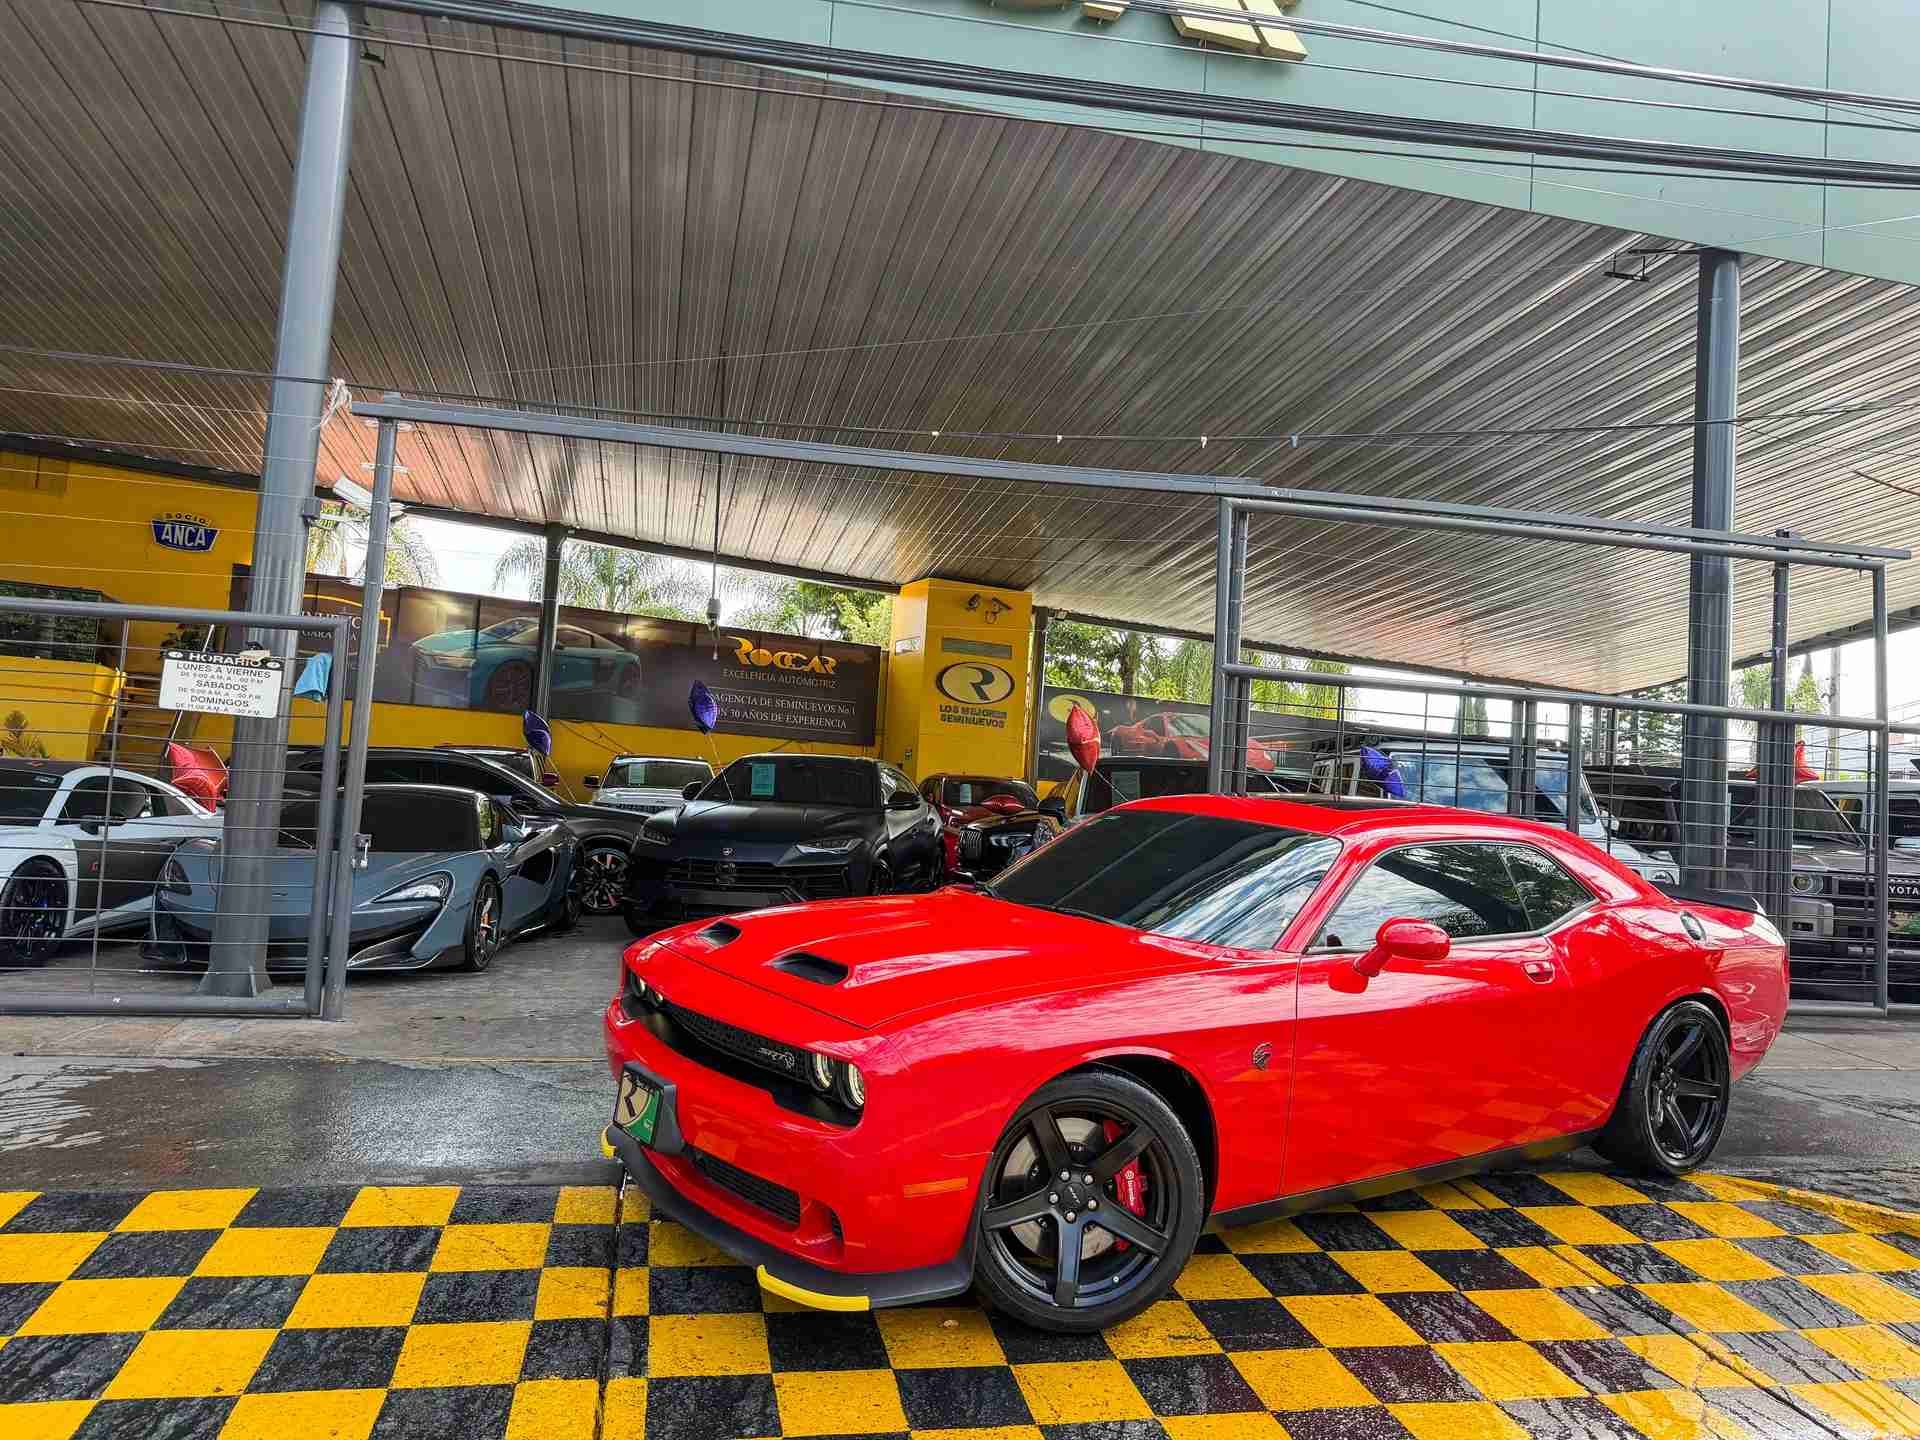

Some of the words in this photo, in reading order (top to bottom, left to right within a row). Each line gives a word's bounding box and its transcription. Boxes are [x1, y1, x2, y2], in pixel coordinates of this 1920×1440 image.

[161, 524, 206, 546] ANCA
[189, 652, 261, 667] HORARIO
[727, 635, 839, 674] ROCCAR
[176, 662, 212, 673] LUNES
[214, 665, 222, 673] A
[226, 667, 271, 679] VIERNES
[723, 668, 776, 682] EXCELENCIA
[779, 675, 837, 689] AUTOMOTRIZ
[195, 680, 248, 692] SABADOS
[190, 694, 250, 708] DOMINGOS
[714, 693, 758, 706] AGENCIA
[760, 697, 774, 708] DE
[775, 698, 836, 713] SEMINUEVOS
[939, 704, 959, 713] LOS
[741, 709, 768, 721] AÑOS
[771, 711, 784, 722] DE
[785, 713, 847, 729] EXPERIENCIA
[940, 714, 1005, 728] SEMINUEVOS
[1888, 886, 1919, 896] YOTA
